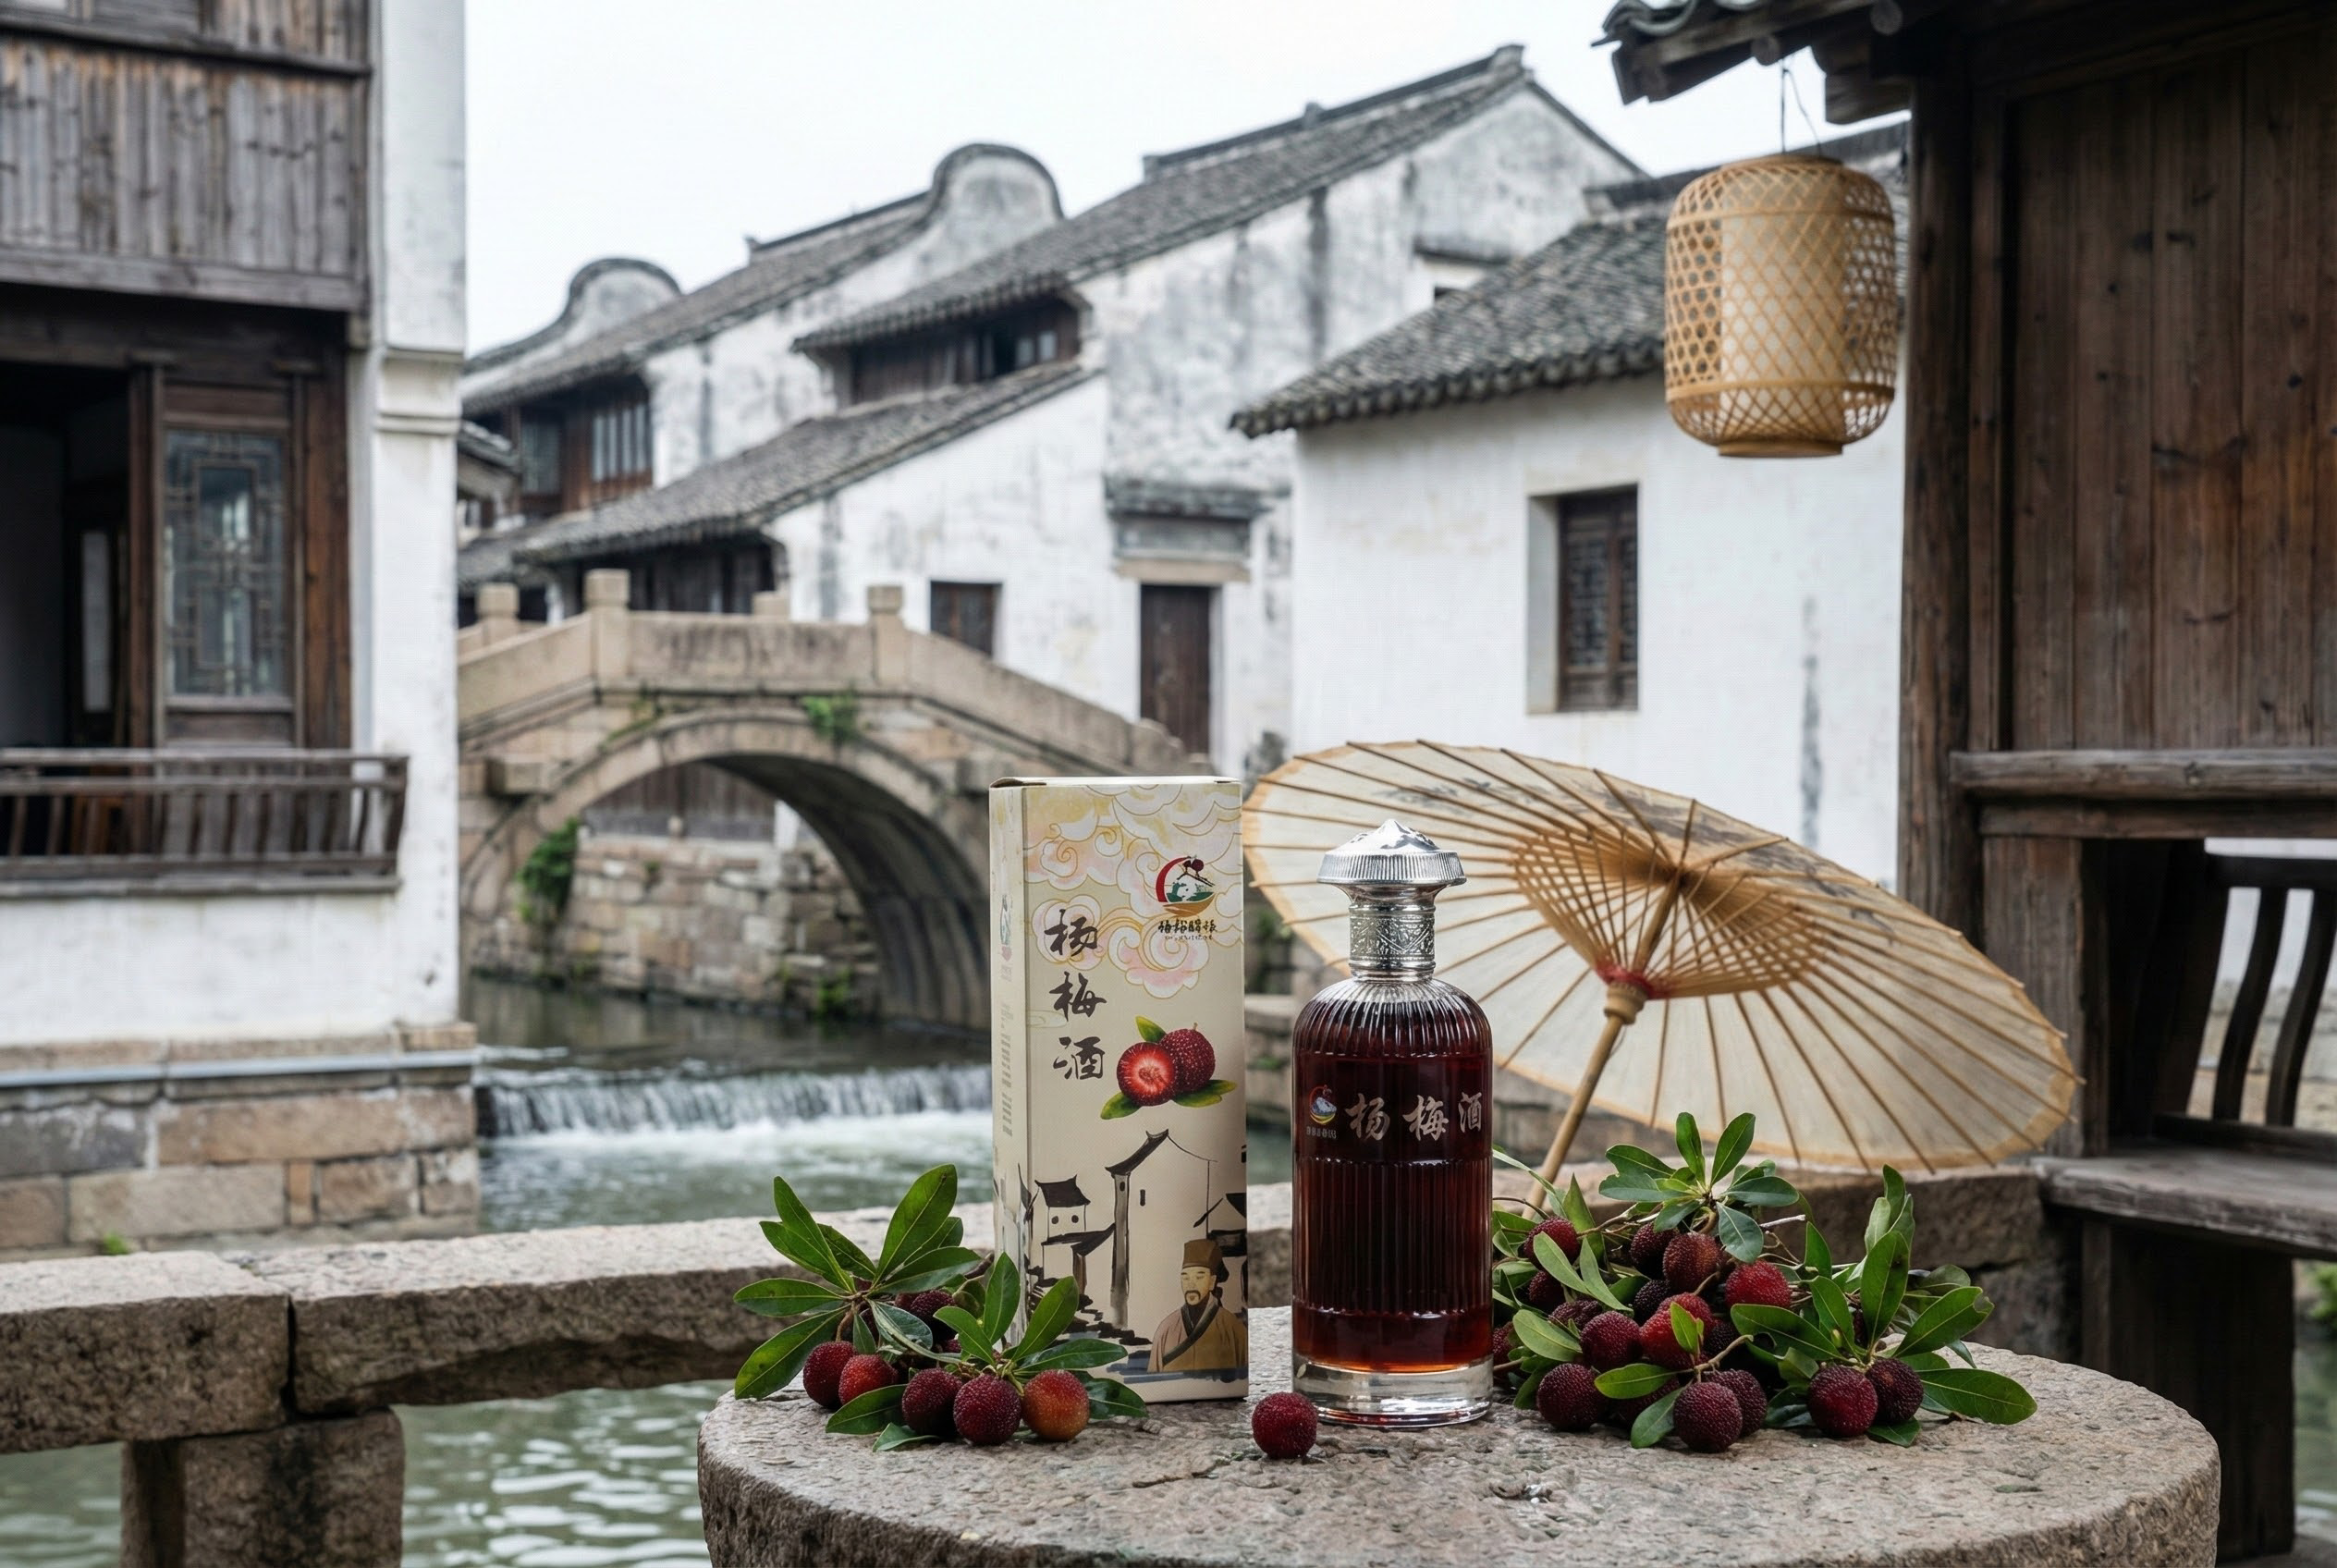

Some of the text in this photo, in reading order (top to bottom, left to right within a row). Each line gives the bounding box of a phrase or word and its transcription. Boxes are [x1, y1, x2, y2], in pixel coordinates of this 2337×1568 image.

[1044, 909, 1107, 1081] 杨梅酒
[1345, 1092, 1483, 1142] 杨梅酒
